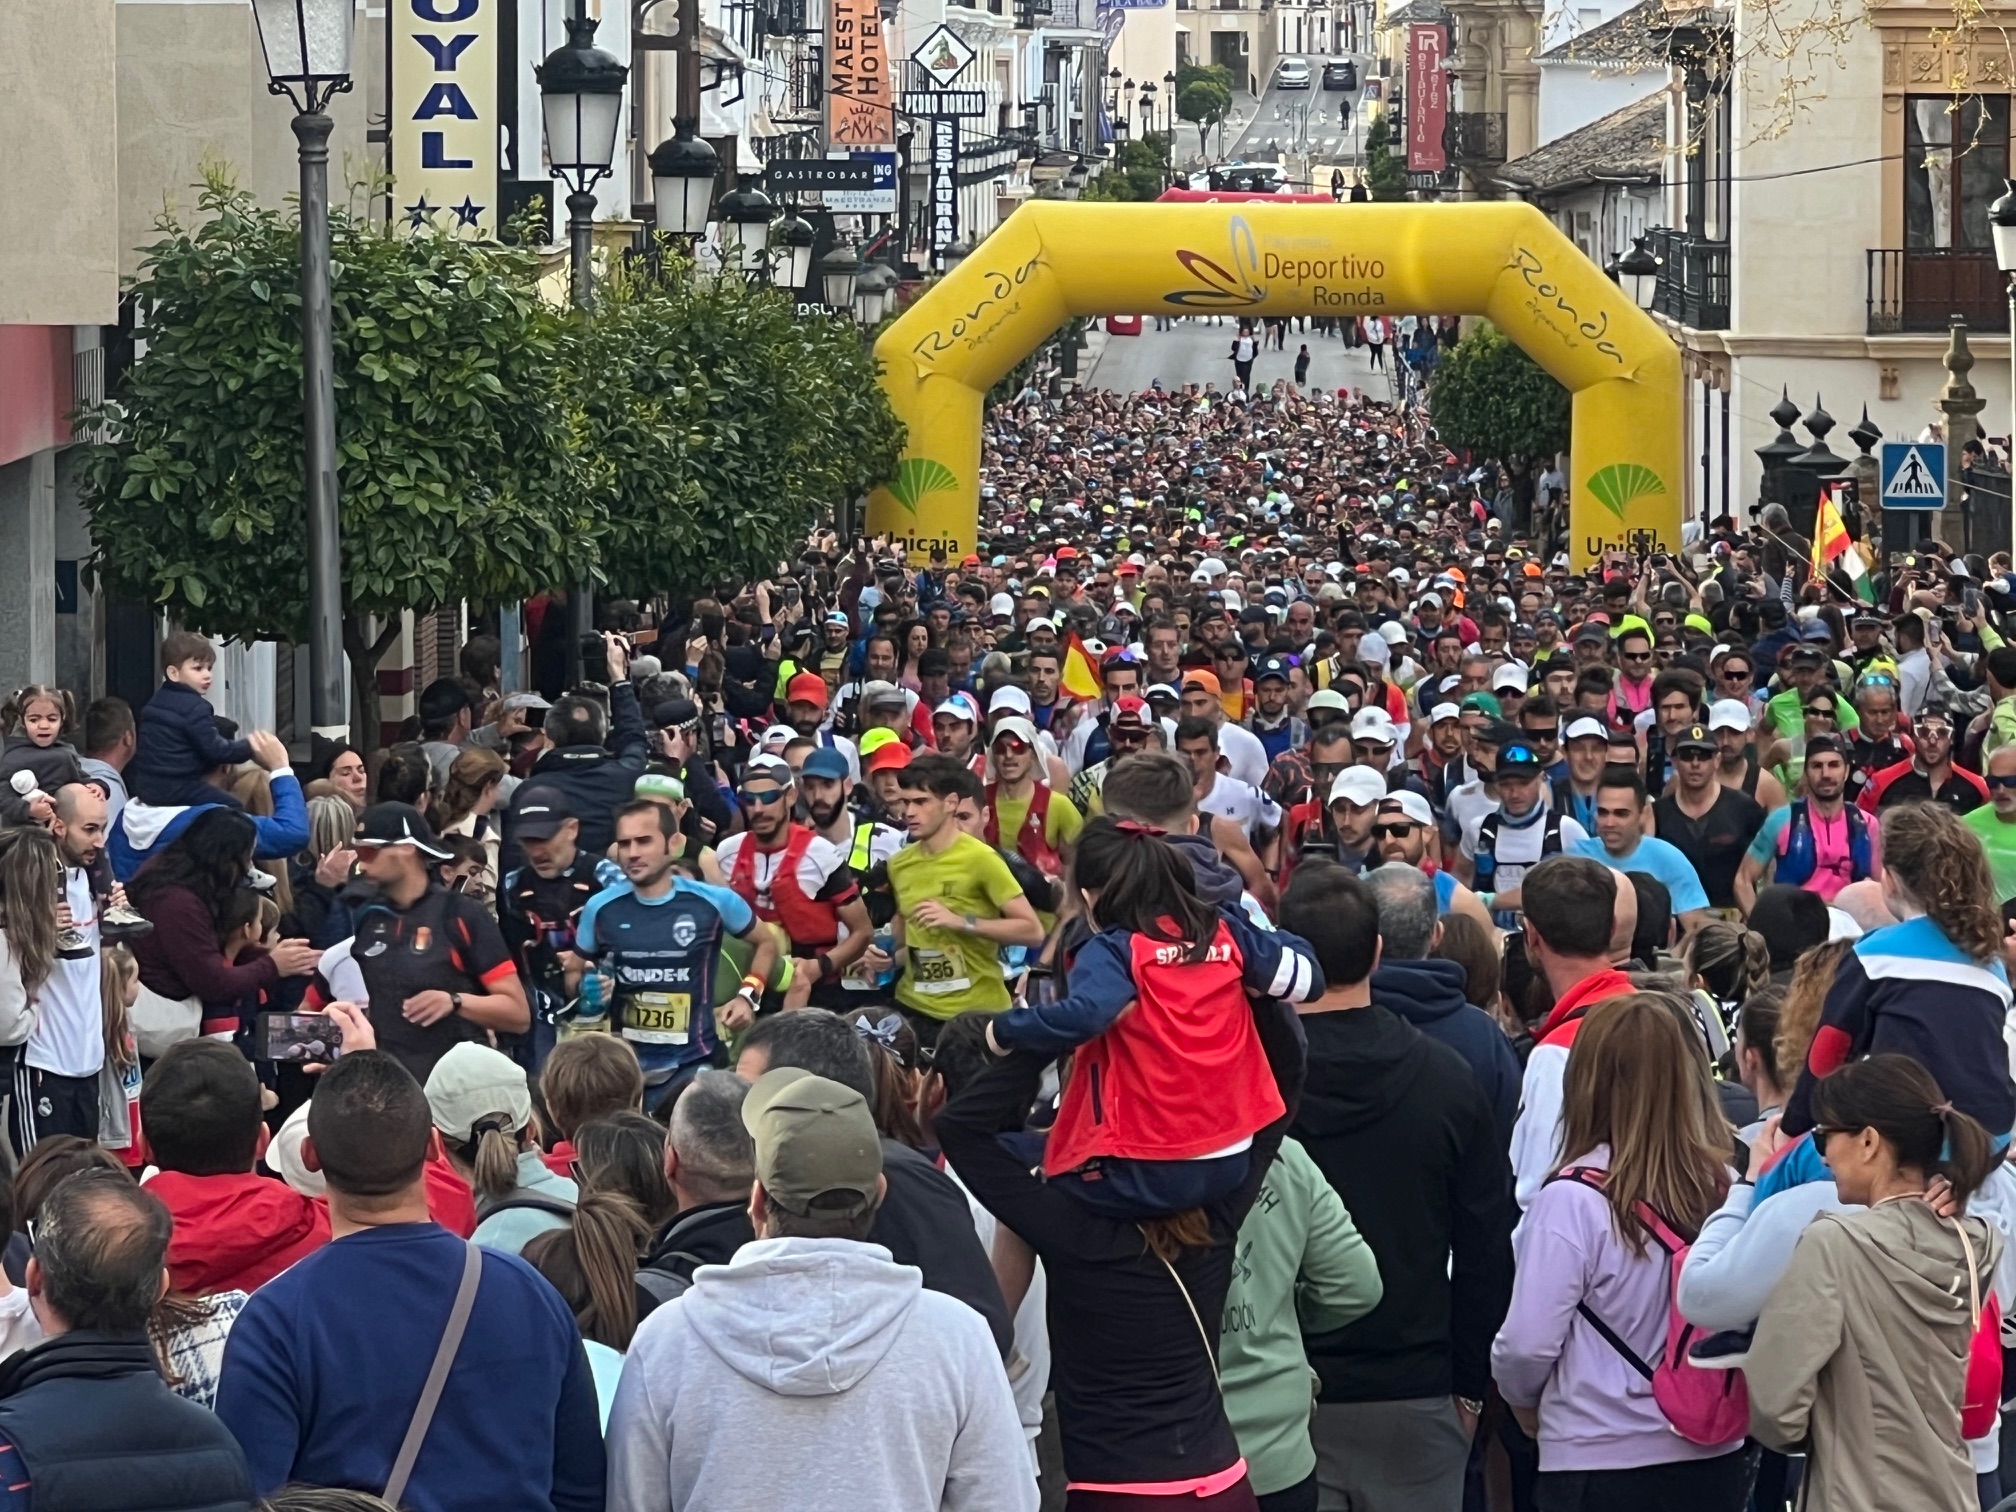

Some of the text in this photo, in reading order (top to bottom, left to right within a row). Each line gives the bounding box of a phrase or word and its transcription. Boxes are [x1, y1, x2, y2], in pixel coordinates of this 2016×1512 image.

[857, 6, 879, 96] HOTEL
[905, 93, 983, 115] PEDRO ROMERO
[774, 170, 868, 180] GASTROBAR
[1264, 252, 1385, 287] Deportivo
[1313, 286, 1385, 306] Ronda
[913, 260, 1037, 362] Ronda
[1586, 533, 1667, 556] Unica
[635, 1008, 675, 1029] 1236
